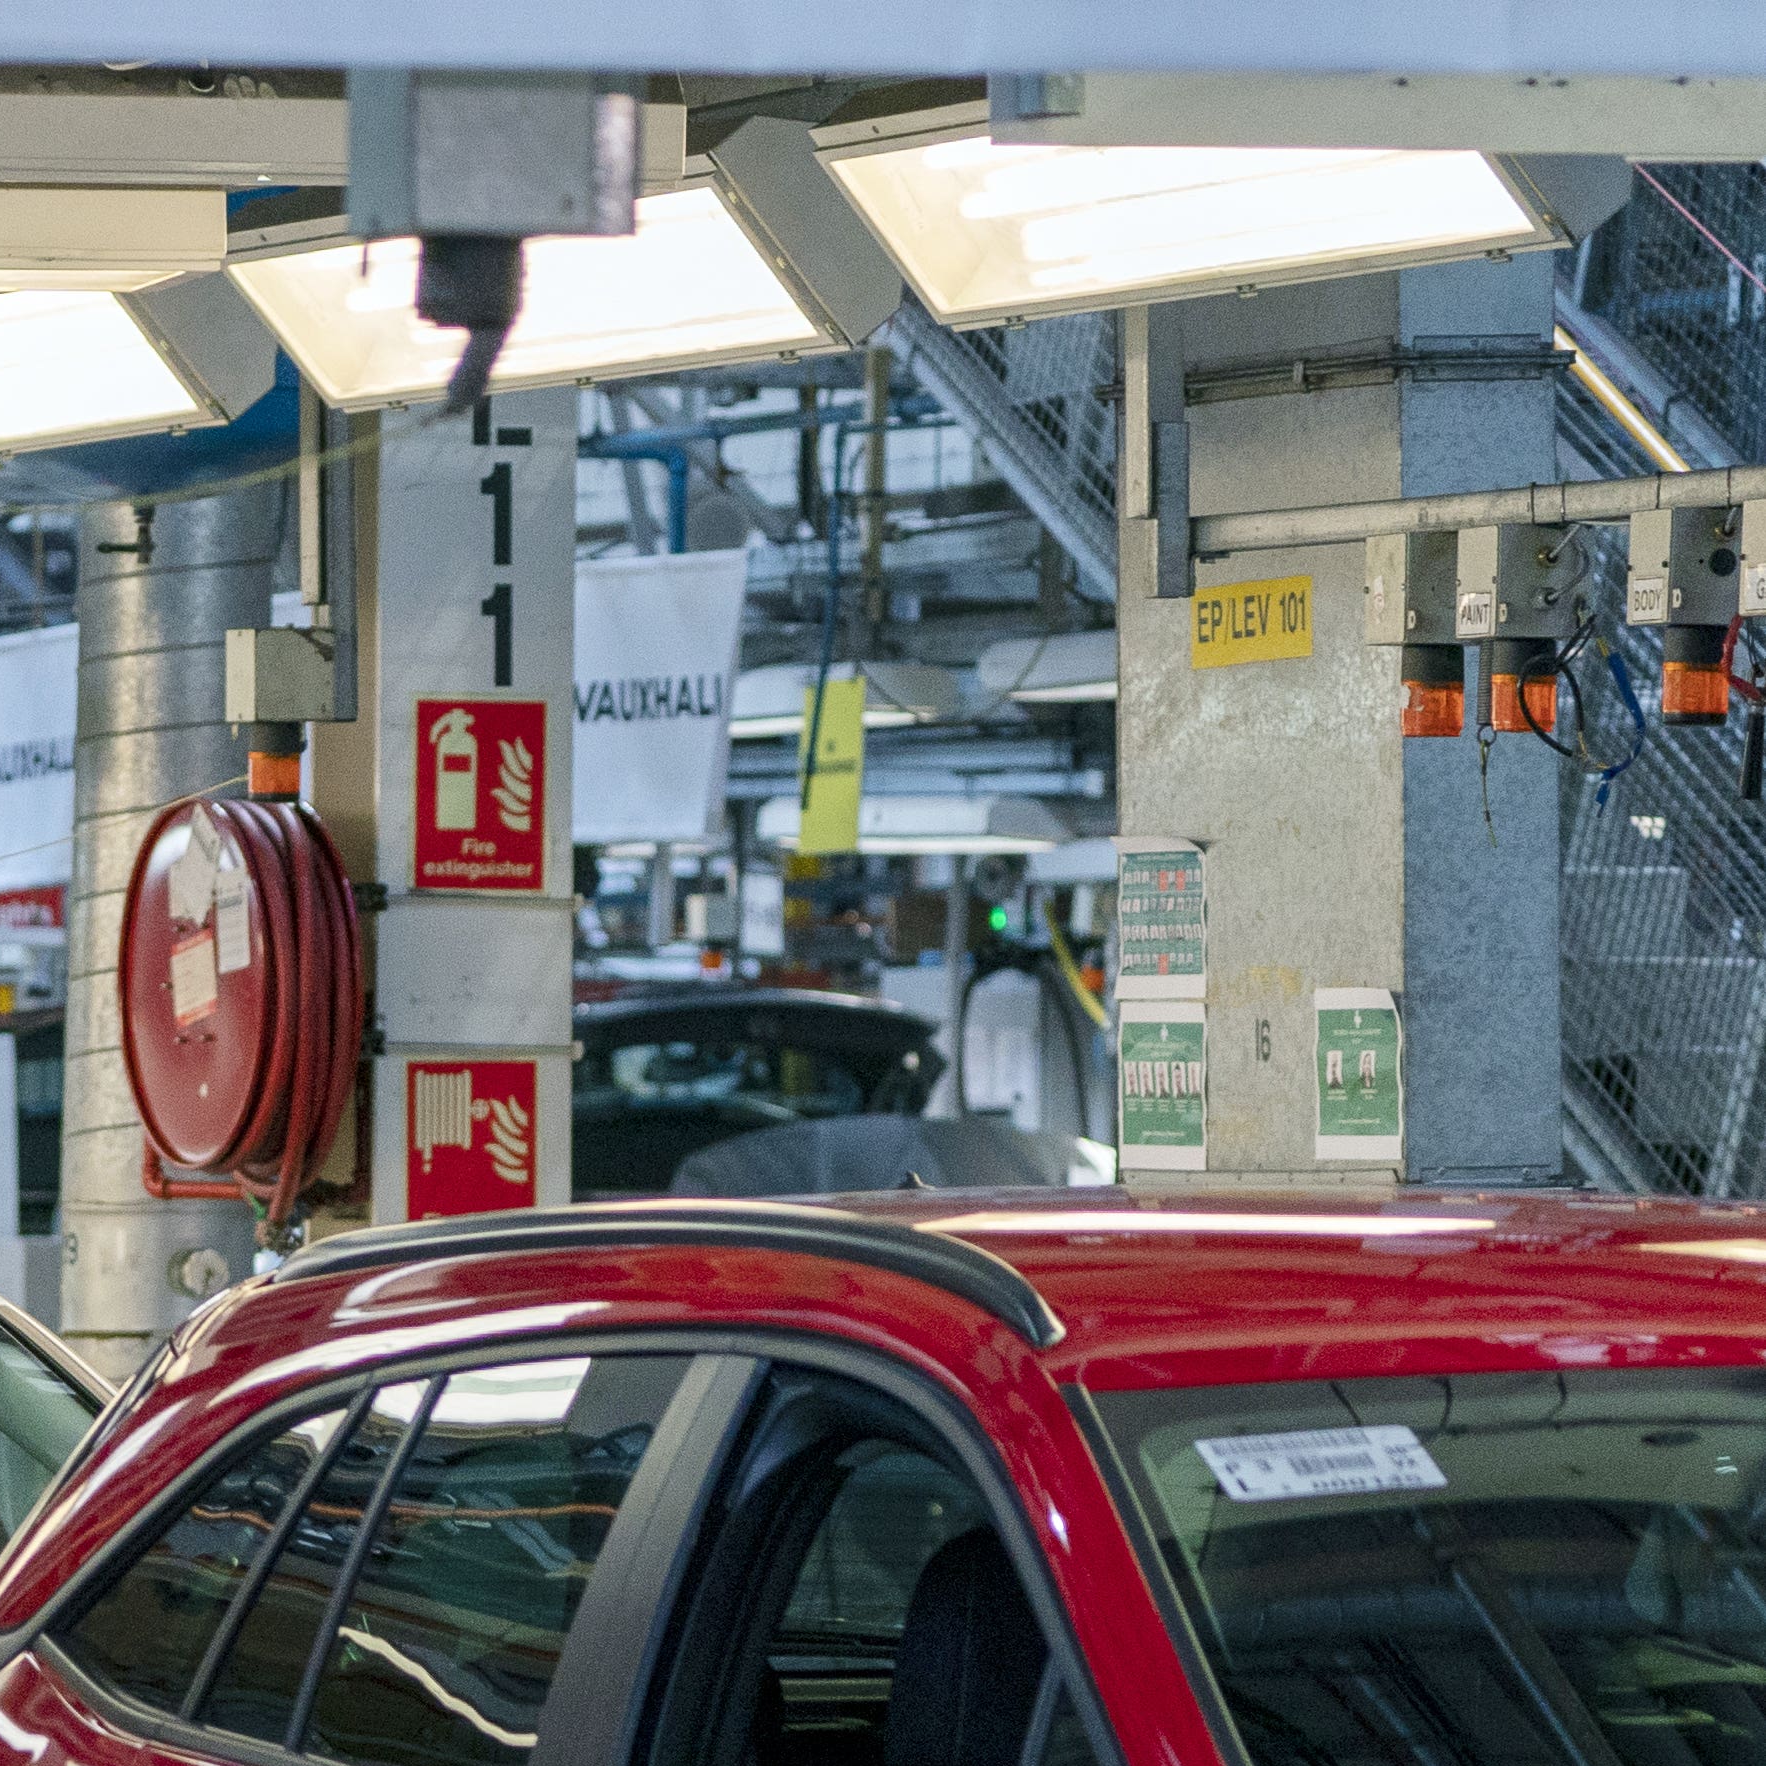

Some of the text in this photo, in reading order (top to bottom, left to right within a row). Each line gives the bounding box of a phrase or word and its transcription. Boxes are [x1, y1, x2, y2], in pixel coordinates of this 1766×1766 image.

[1634, 589, 1663, 611] BODY
[1197, 591, 1306, 644] EP/LEV 101
[1460, 603, 1489, 625] PAINT
[461, 838, 496, 856] Fire
[423, 859, 533, 881] extinguisher
[1254, 1018, 1270, 1062] 16
